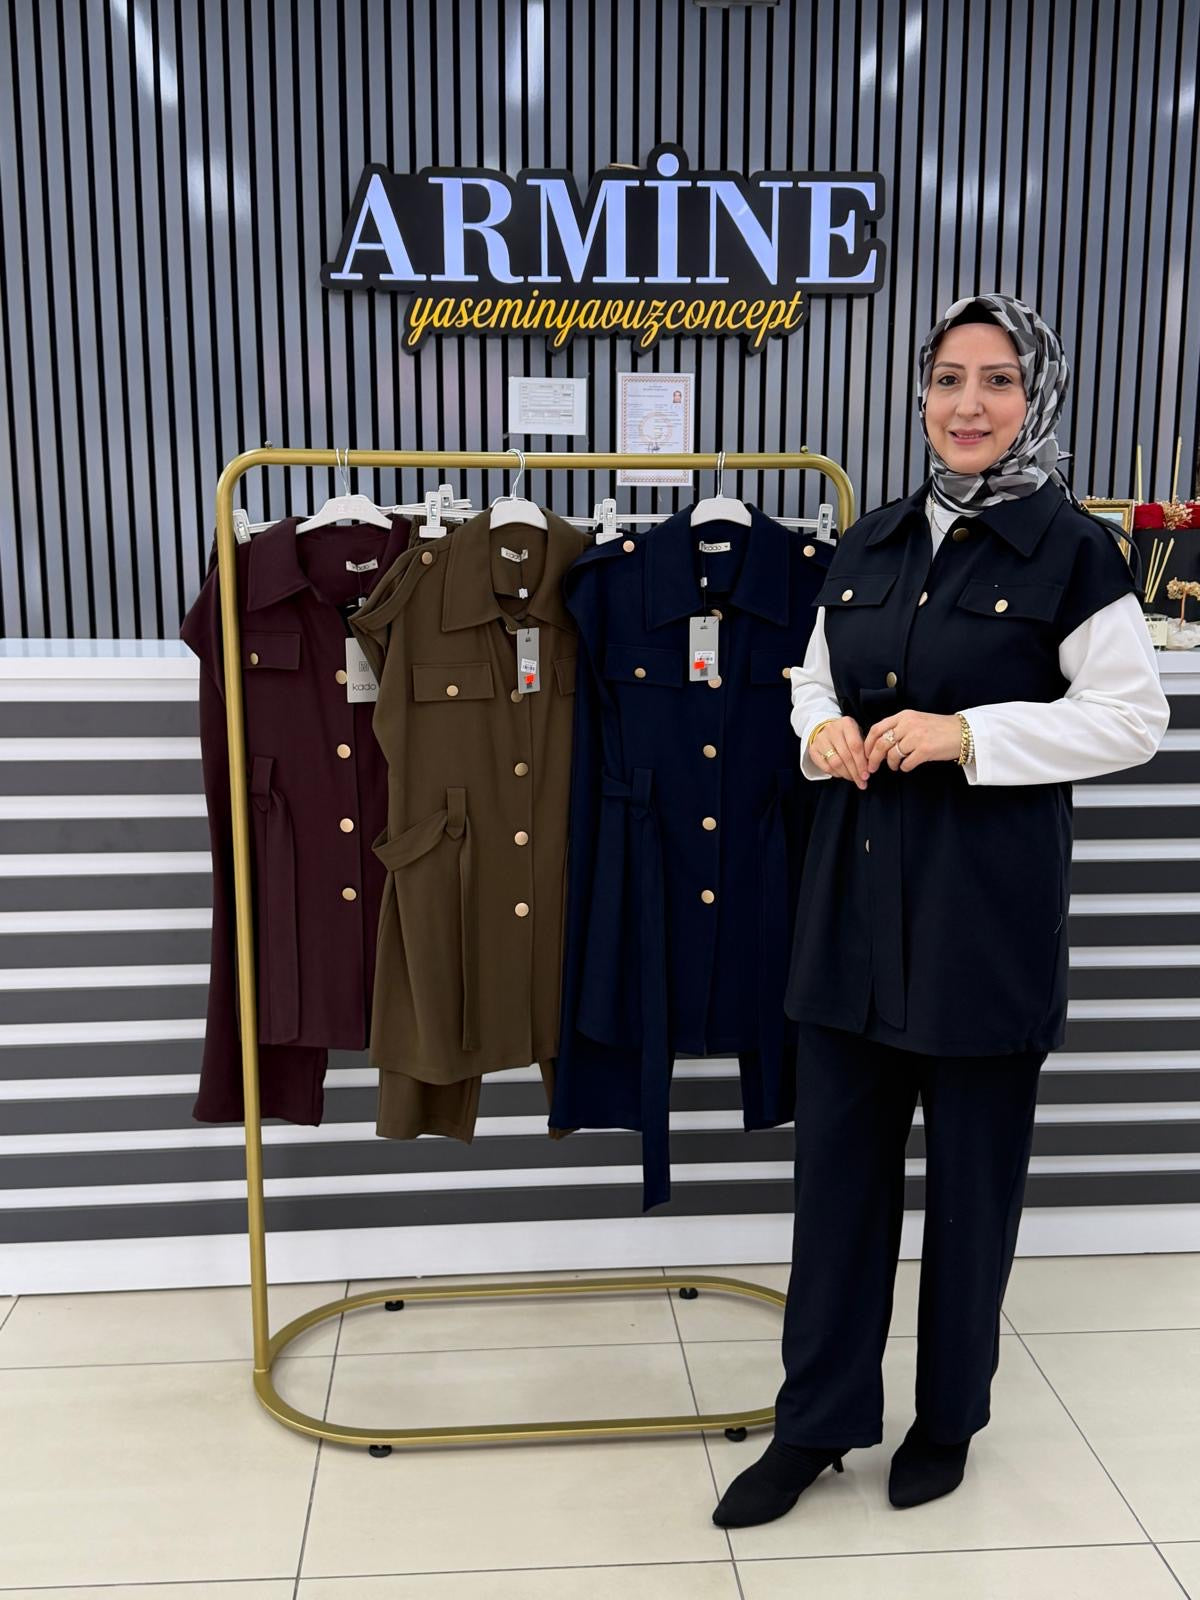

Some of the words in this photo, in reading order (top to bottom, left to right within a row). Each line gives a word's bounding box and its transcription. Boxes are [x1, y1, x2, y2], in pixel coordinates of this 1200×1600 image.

[331, 153, 877, 285] ARMİNE
[408, 290, 803, 347] yaseminyavuzconcept
[352, 682, 376, 691] kado
